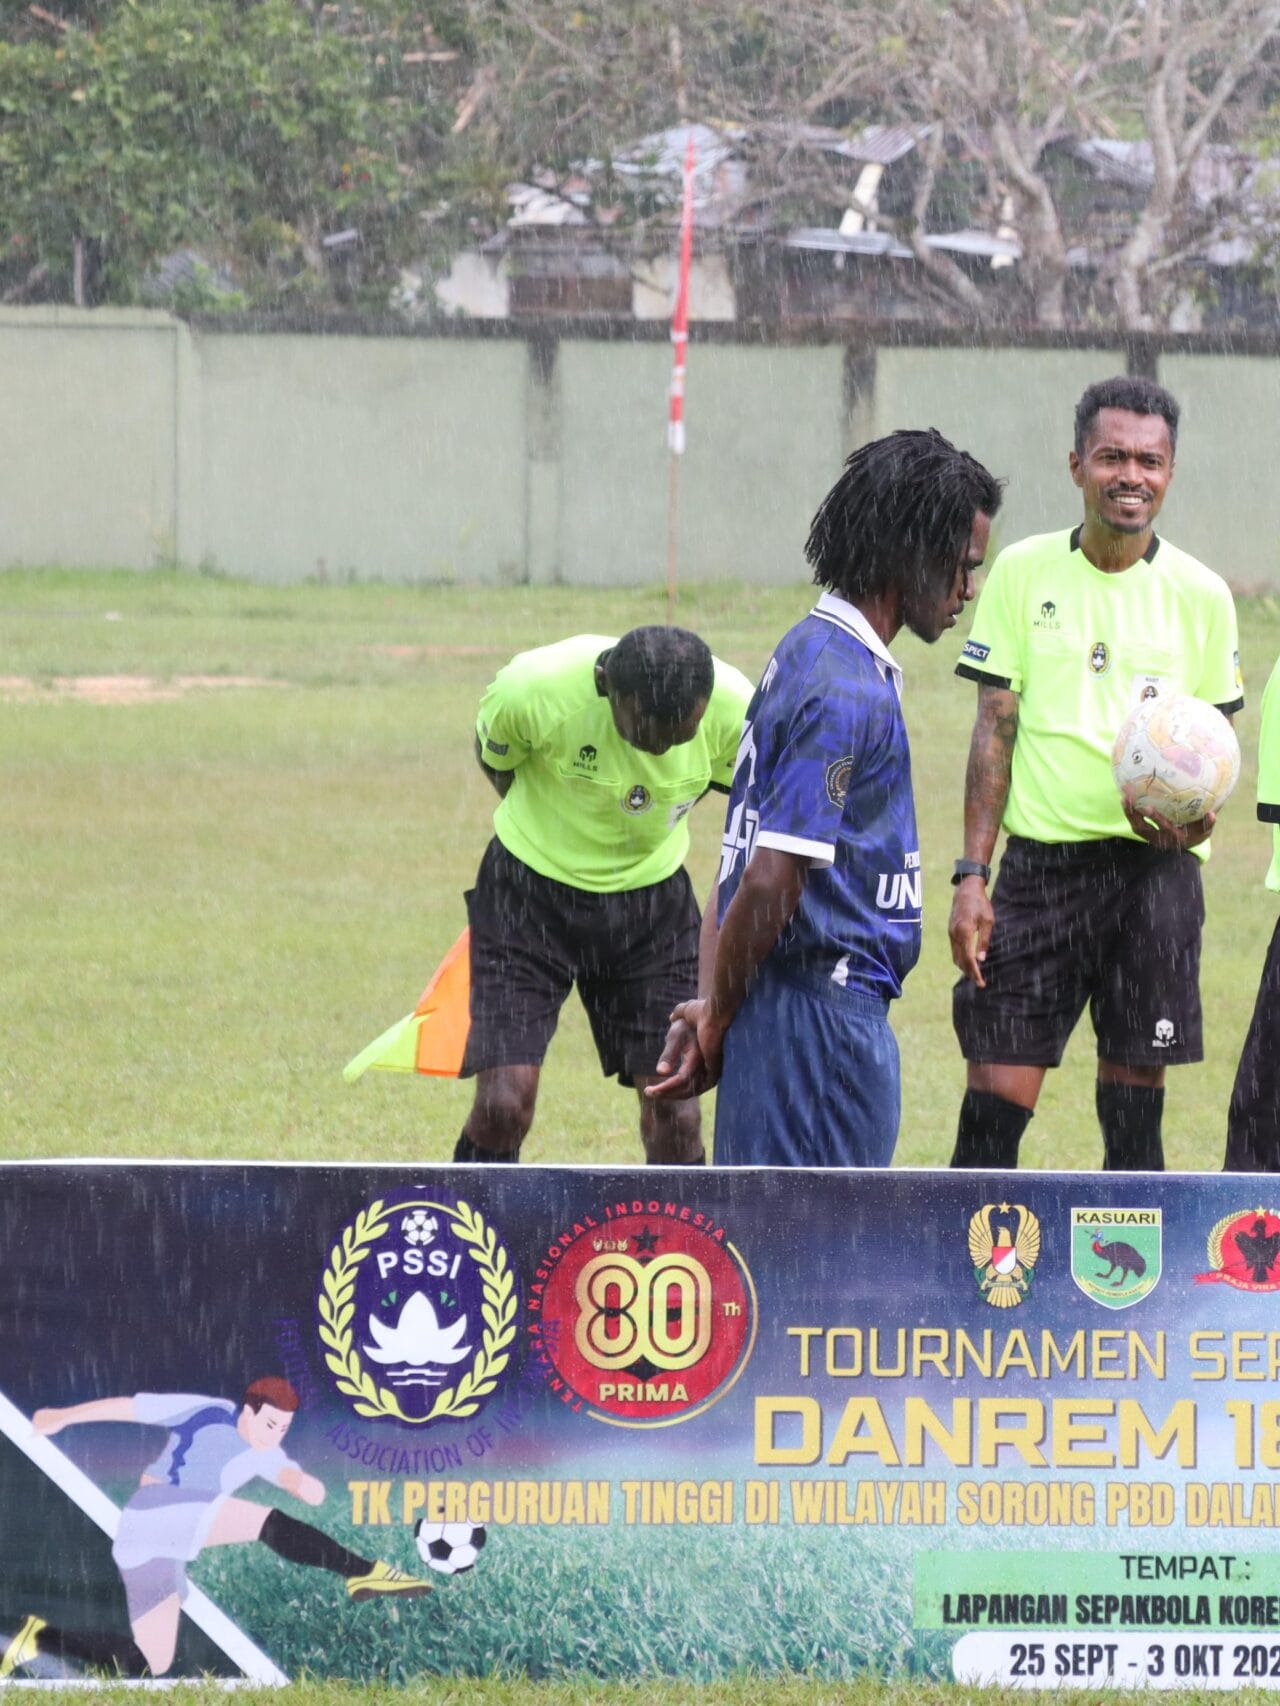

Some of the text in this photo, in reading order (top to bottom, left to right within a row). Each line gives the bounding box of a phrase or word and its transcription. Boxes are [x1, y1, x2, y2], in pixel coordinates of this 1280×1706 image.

[1033, 620, 1061, 630] MILLS
[573, 761, 598, 772] MILLS
[1077, 1212, 1156, 1225] KASUARI
[377, 1250, 462, 1279] PSSI
[528, 1215, 597, 1311] NASIONAL
[605, 1200, 726, 1241] INDONESIA
[1216, 1272, 1249, 1290] PRAJA
[575, 1252, 712, 1371] 80
[722, 1302, 742, 1317] Th
[786, 1327, 1167, 1380] TOURNAMEN
[599, 1383, 689, 1402] PRIMA
[753, 1395, 1198, 1469] DANREM
[326, 1422, 463, 1475] ASSOCIATION
[466, 1425, 499, 1458] OF
[347, 1480, 392, 1526] TK
[403, 1480, 610, 1526] PERGURUAN
[620, 1480, 734, 1526] TINGGI
[744, 1479, 779, 1526] DI
[790, 1480, 947, 1526] WILAYAH
[956, 1481, 1096, 1527] SORONG
[1105, 1482, 1175, 1528] PBD
[1119, 1555, 1237, 1581] TEMPAT
[942, 1594, 1067, 1625] LAPANGAN
[1075, 1594, 1211, 1626] SEPAKBOLA
[1009, 1643, 1046, 1677] 25
[1055, 1644, 1118, 1677] SEPT
[1147, 1644, 1165, 1677] 3
[1174, 1645, 1224, 1678] OKT
